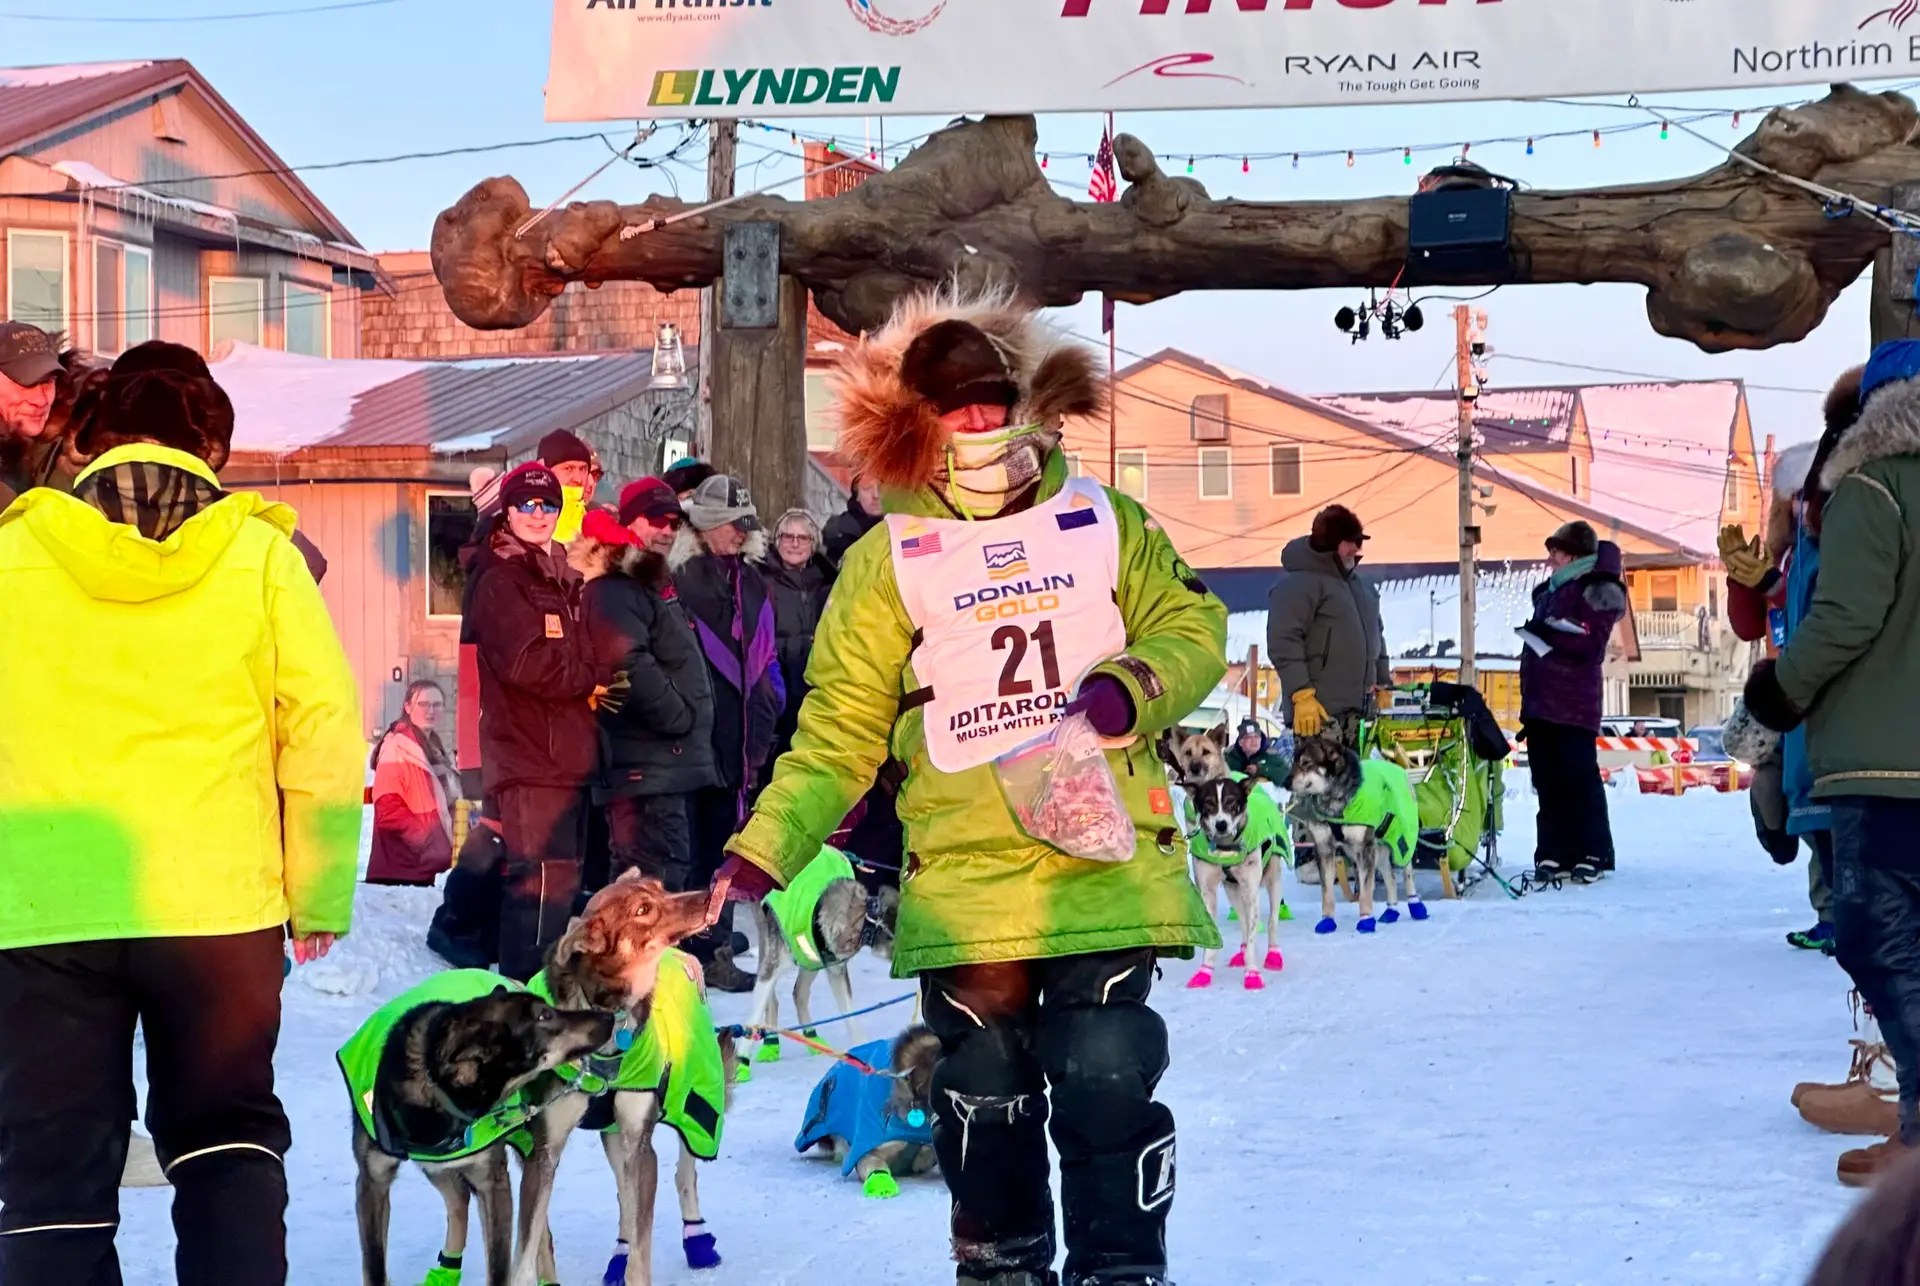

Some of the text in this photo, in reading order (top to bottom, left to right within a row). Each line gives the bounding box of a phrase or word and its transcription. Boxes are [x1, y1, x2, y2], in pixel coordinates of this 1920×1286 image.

[1285, 51, 1481, 75] RYAN AIR
[1733, 40, 1892, 73] Northrim
[694, 66, 901, 106] LYNDEN
[1338, 77, 1480, 93] The Tough Get Going
[953, 573, 1075, 611] DONLIN
[975, 595, 1059, 622] GOLD
[990, 619, 1061, 697] 21
[949, 691, 1068, 731] IDITAROD
[956, 724, 999, 744] MUSH
[1003, 715, 1044, 731] WITH
